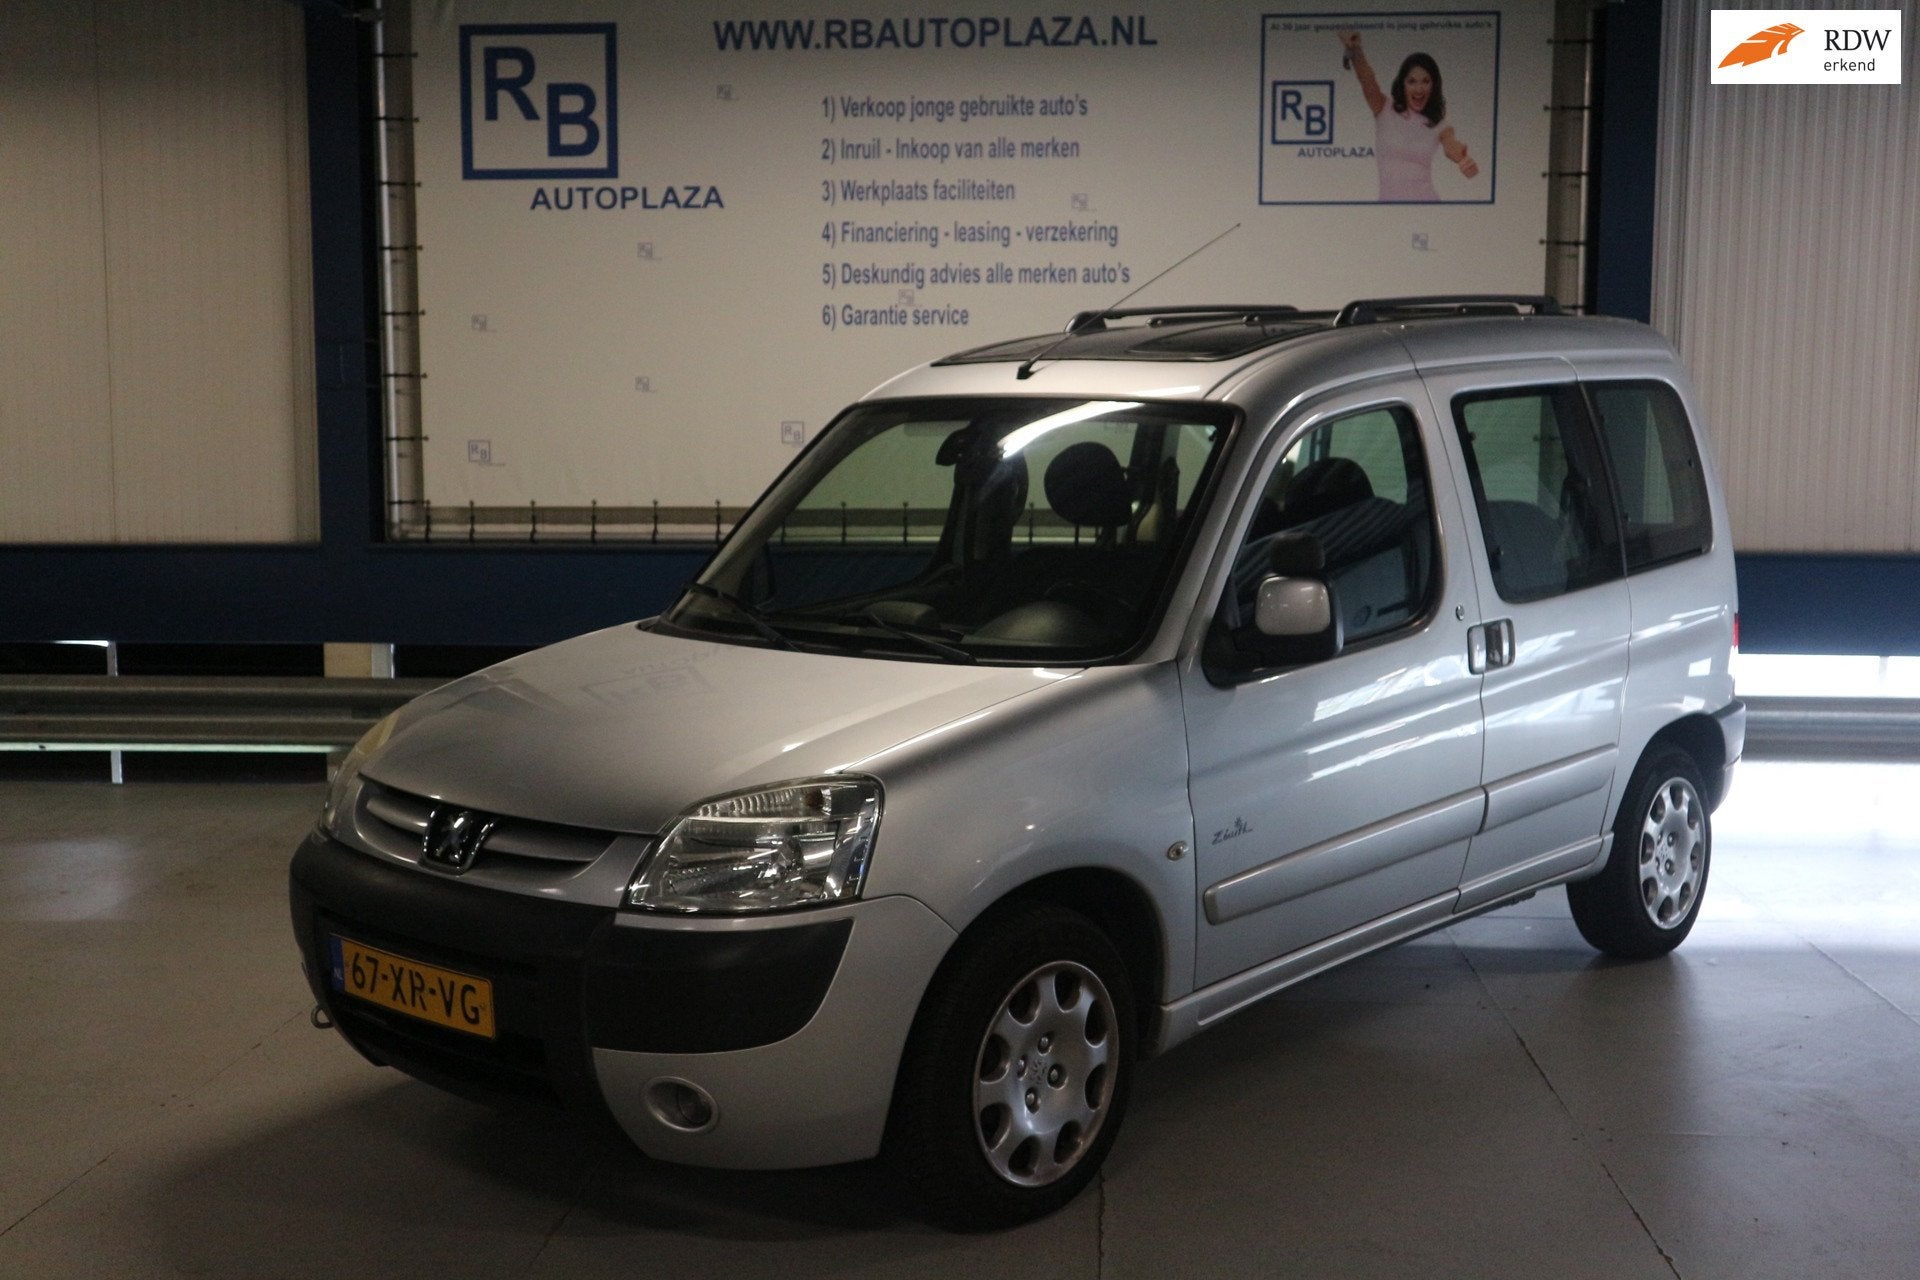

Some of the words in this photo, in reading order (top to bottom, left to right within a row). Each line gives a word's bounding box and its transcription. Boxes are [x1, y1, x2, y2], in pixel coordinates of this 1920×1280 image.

[713, 15, 1158, 51] WWW.RBAUTOPLAZA.NL
[483, 46, 600, 157] RB
[822, 97, 835, 123] 1)
[840, 96, 906, 121] Verkoop
[910, 96, 954, 122] jonge
[960, 95, 1035, 122] gebruikte
[1039, 94, 1088, 116] auto's
[1281, 89, 1327, 136] RB
[821, 138, 835, 164] 2)
[841, 138, 881, 160] Inruil
[896, 138, 949, 163] Inkoop
[955, 143, 983, 158] van
[988, 137, 1016, 158] alle
[1021, 136, 1080, 158] merken
[1297, 147, 1375, 157] AUTOPLAZA
[530, 186, 725, 210] AUTOPLAZA
[821, 180, 836, 206] 3)
[841, 179, 928, 205] Werkplaats
[934, 178, 1016, 200] faciliteiten
[821, 222, 836, 247] 4)
[841, 221, 939, 247] Financiering
[954, 221, 1011, 247] leasing
[1025, 221, 1119, 247] verzekering
[822, 264, 836, 289] 5)
[841, 263, 925, 289] Deskundig
[930, 263, 981, 283] advies
[986, 263, 1012, 283] alle
[1018, 263, 1077, 283] merken
[1082, 263, 1131, 284] auto's
[822, 306, 836, 330] 6)
[841, 304, 907, 326] Garantie
[912, 305, 969, 326] service
[352, 952, 480, 1026] 67-XR-VG
